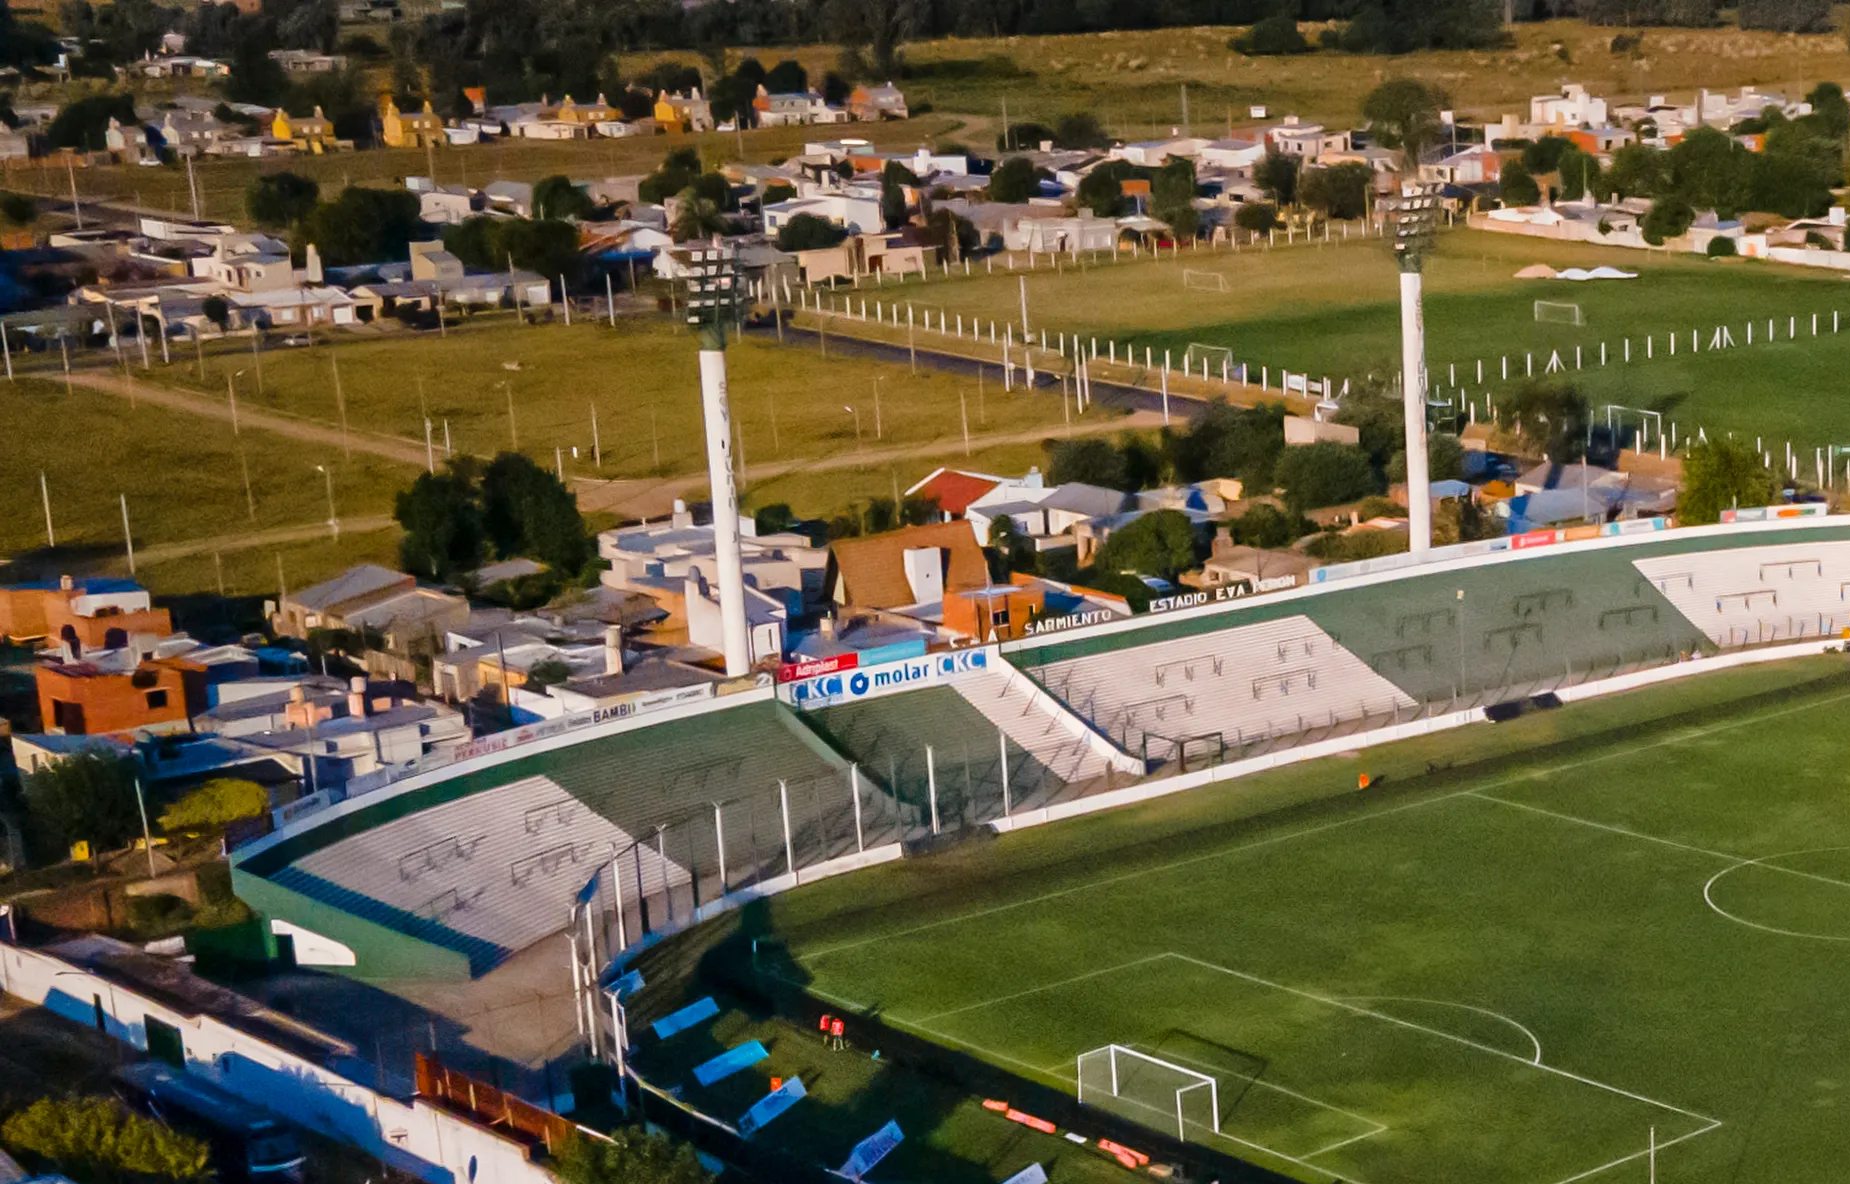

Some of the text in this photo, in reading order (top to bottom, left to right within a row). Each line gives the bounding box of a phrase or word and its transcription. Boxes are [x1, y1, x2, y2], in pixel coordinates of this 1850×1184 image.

[1150, 592, 1208, 613] ESTADIO
[1216, 584, 1246, 602] EVA
[1024, 609, 1112, 636] SARMIENTO
[875, 663, 930, 687] molar
[937, 649, 987, 676] CKC
[790, 674, 844, 704] CKC
